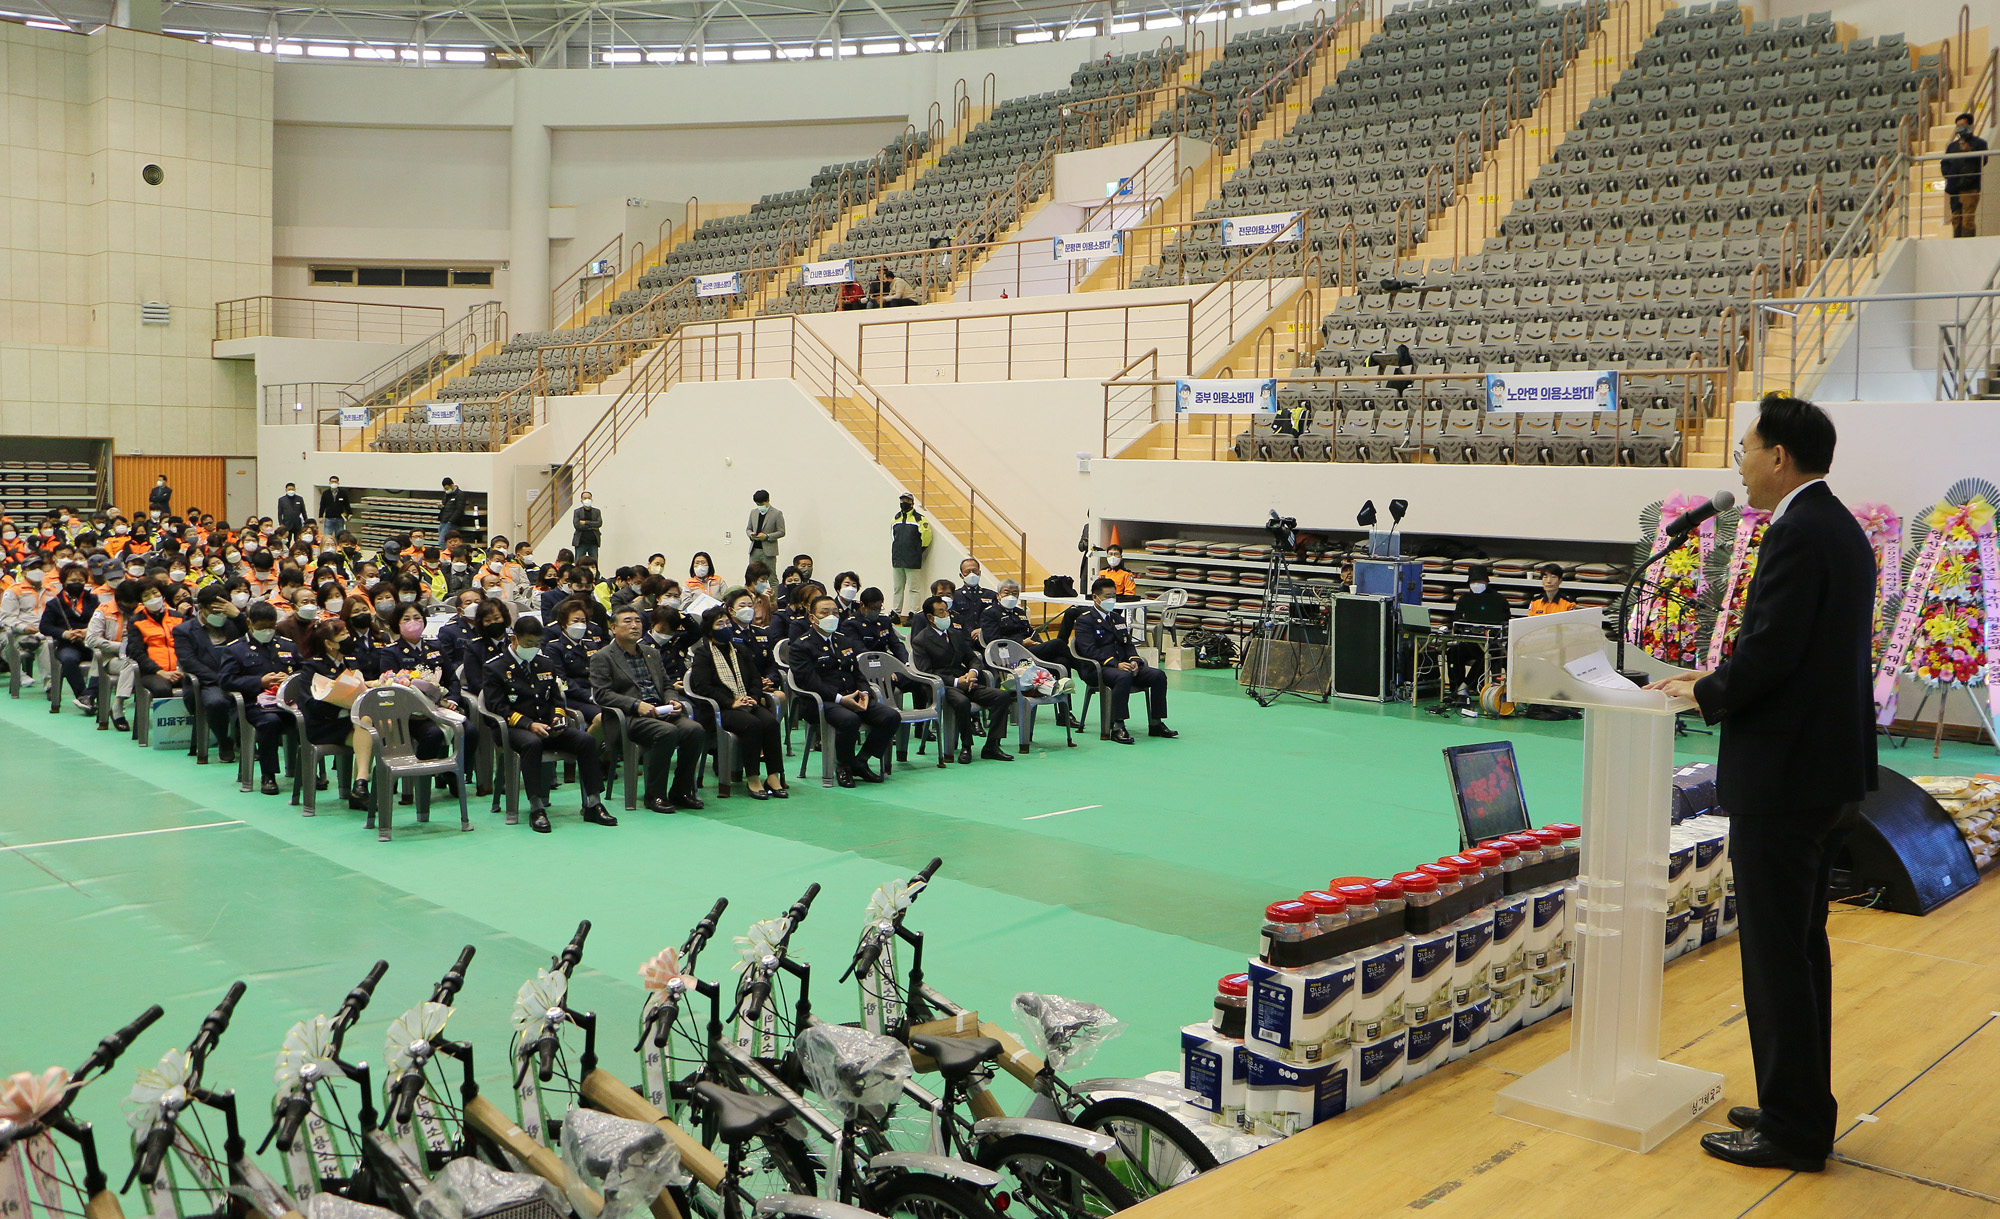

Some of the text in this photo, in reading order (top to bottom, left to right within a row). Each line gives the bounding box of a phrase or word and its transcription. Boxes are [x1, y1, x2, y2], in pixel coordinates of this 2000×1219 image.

[1082, 240, 1111, 251] 의용소방대
[1195, 391, 1254, 404] 중부 의용소방대
[1507, 386, 1594, 401] 노안면 의용소방대
